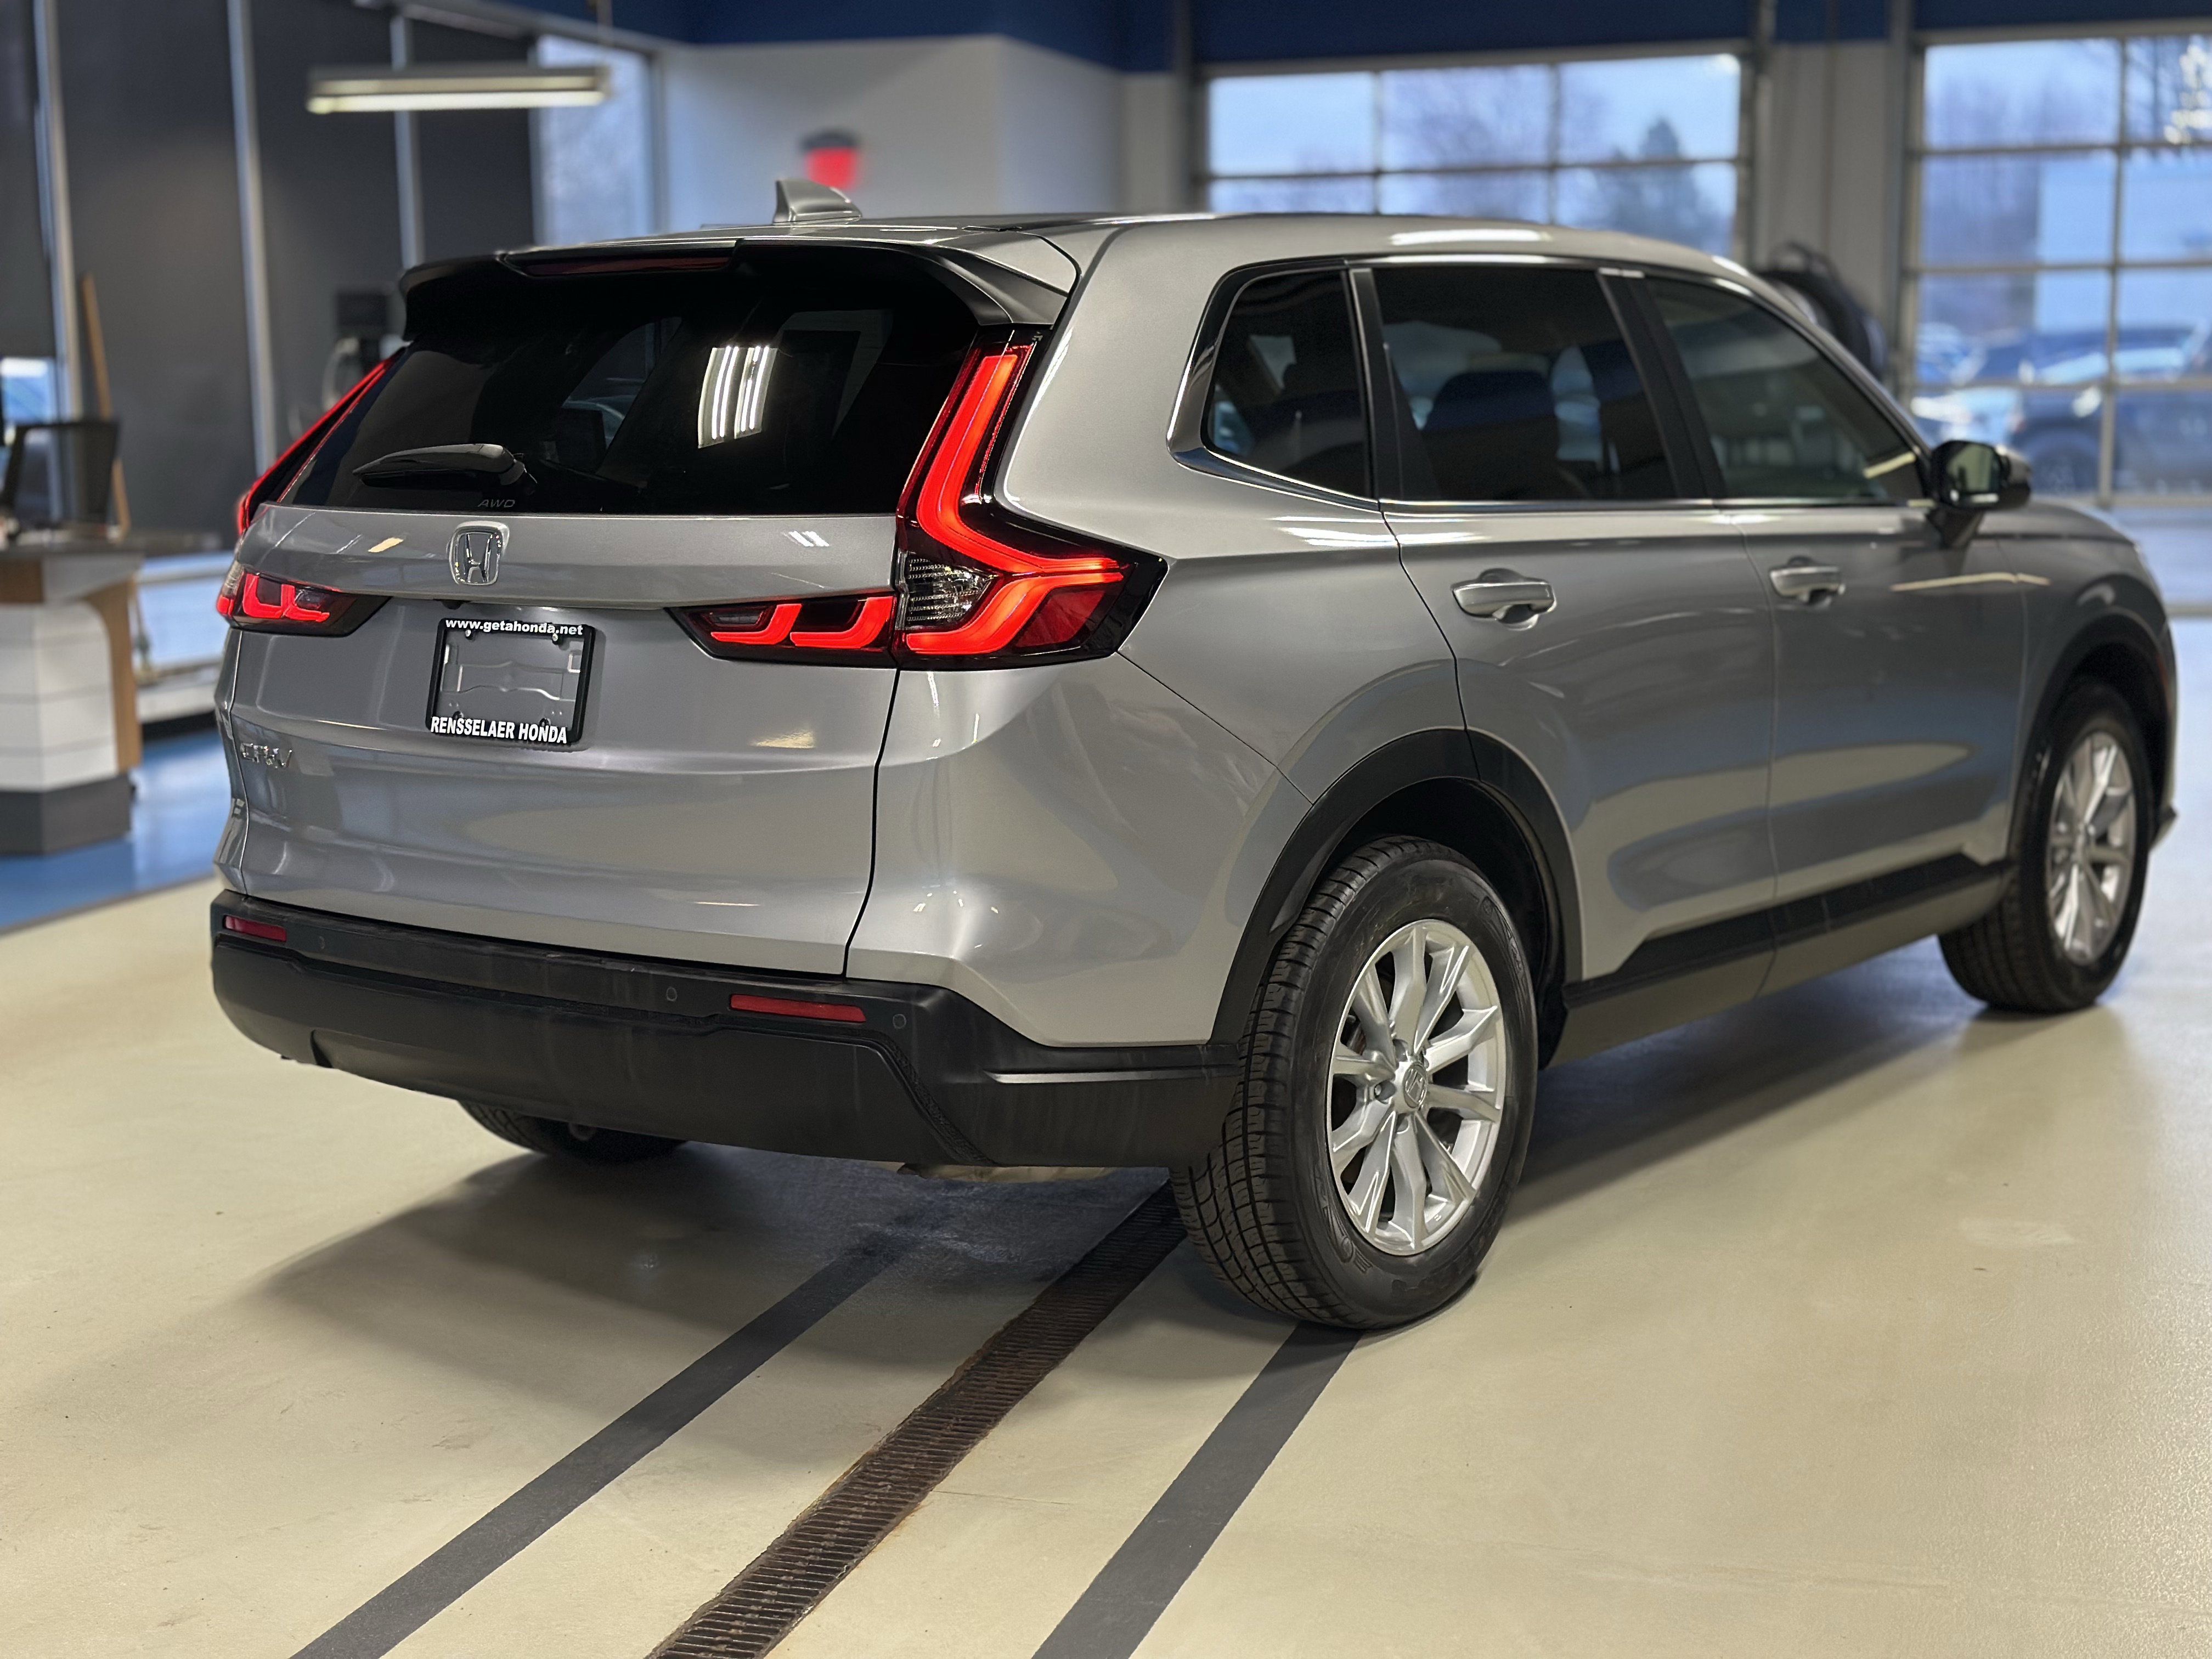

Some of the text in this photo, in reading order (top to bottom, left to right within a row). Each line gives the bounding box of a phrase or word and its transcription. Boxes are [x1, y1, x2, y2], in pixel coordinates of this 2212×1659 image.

[477, 499, 515, 507] AWD
[445, 619, 583, 635] www.getahonda.net
[431, 716, 567, 743] RENSSELAER HONDA
